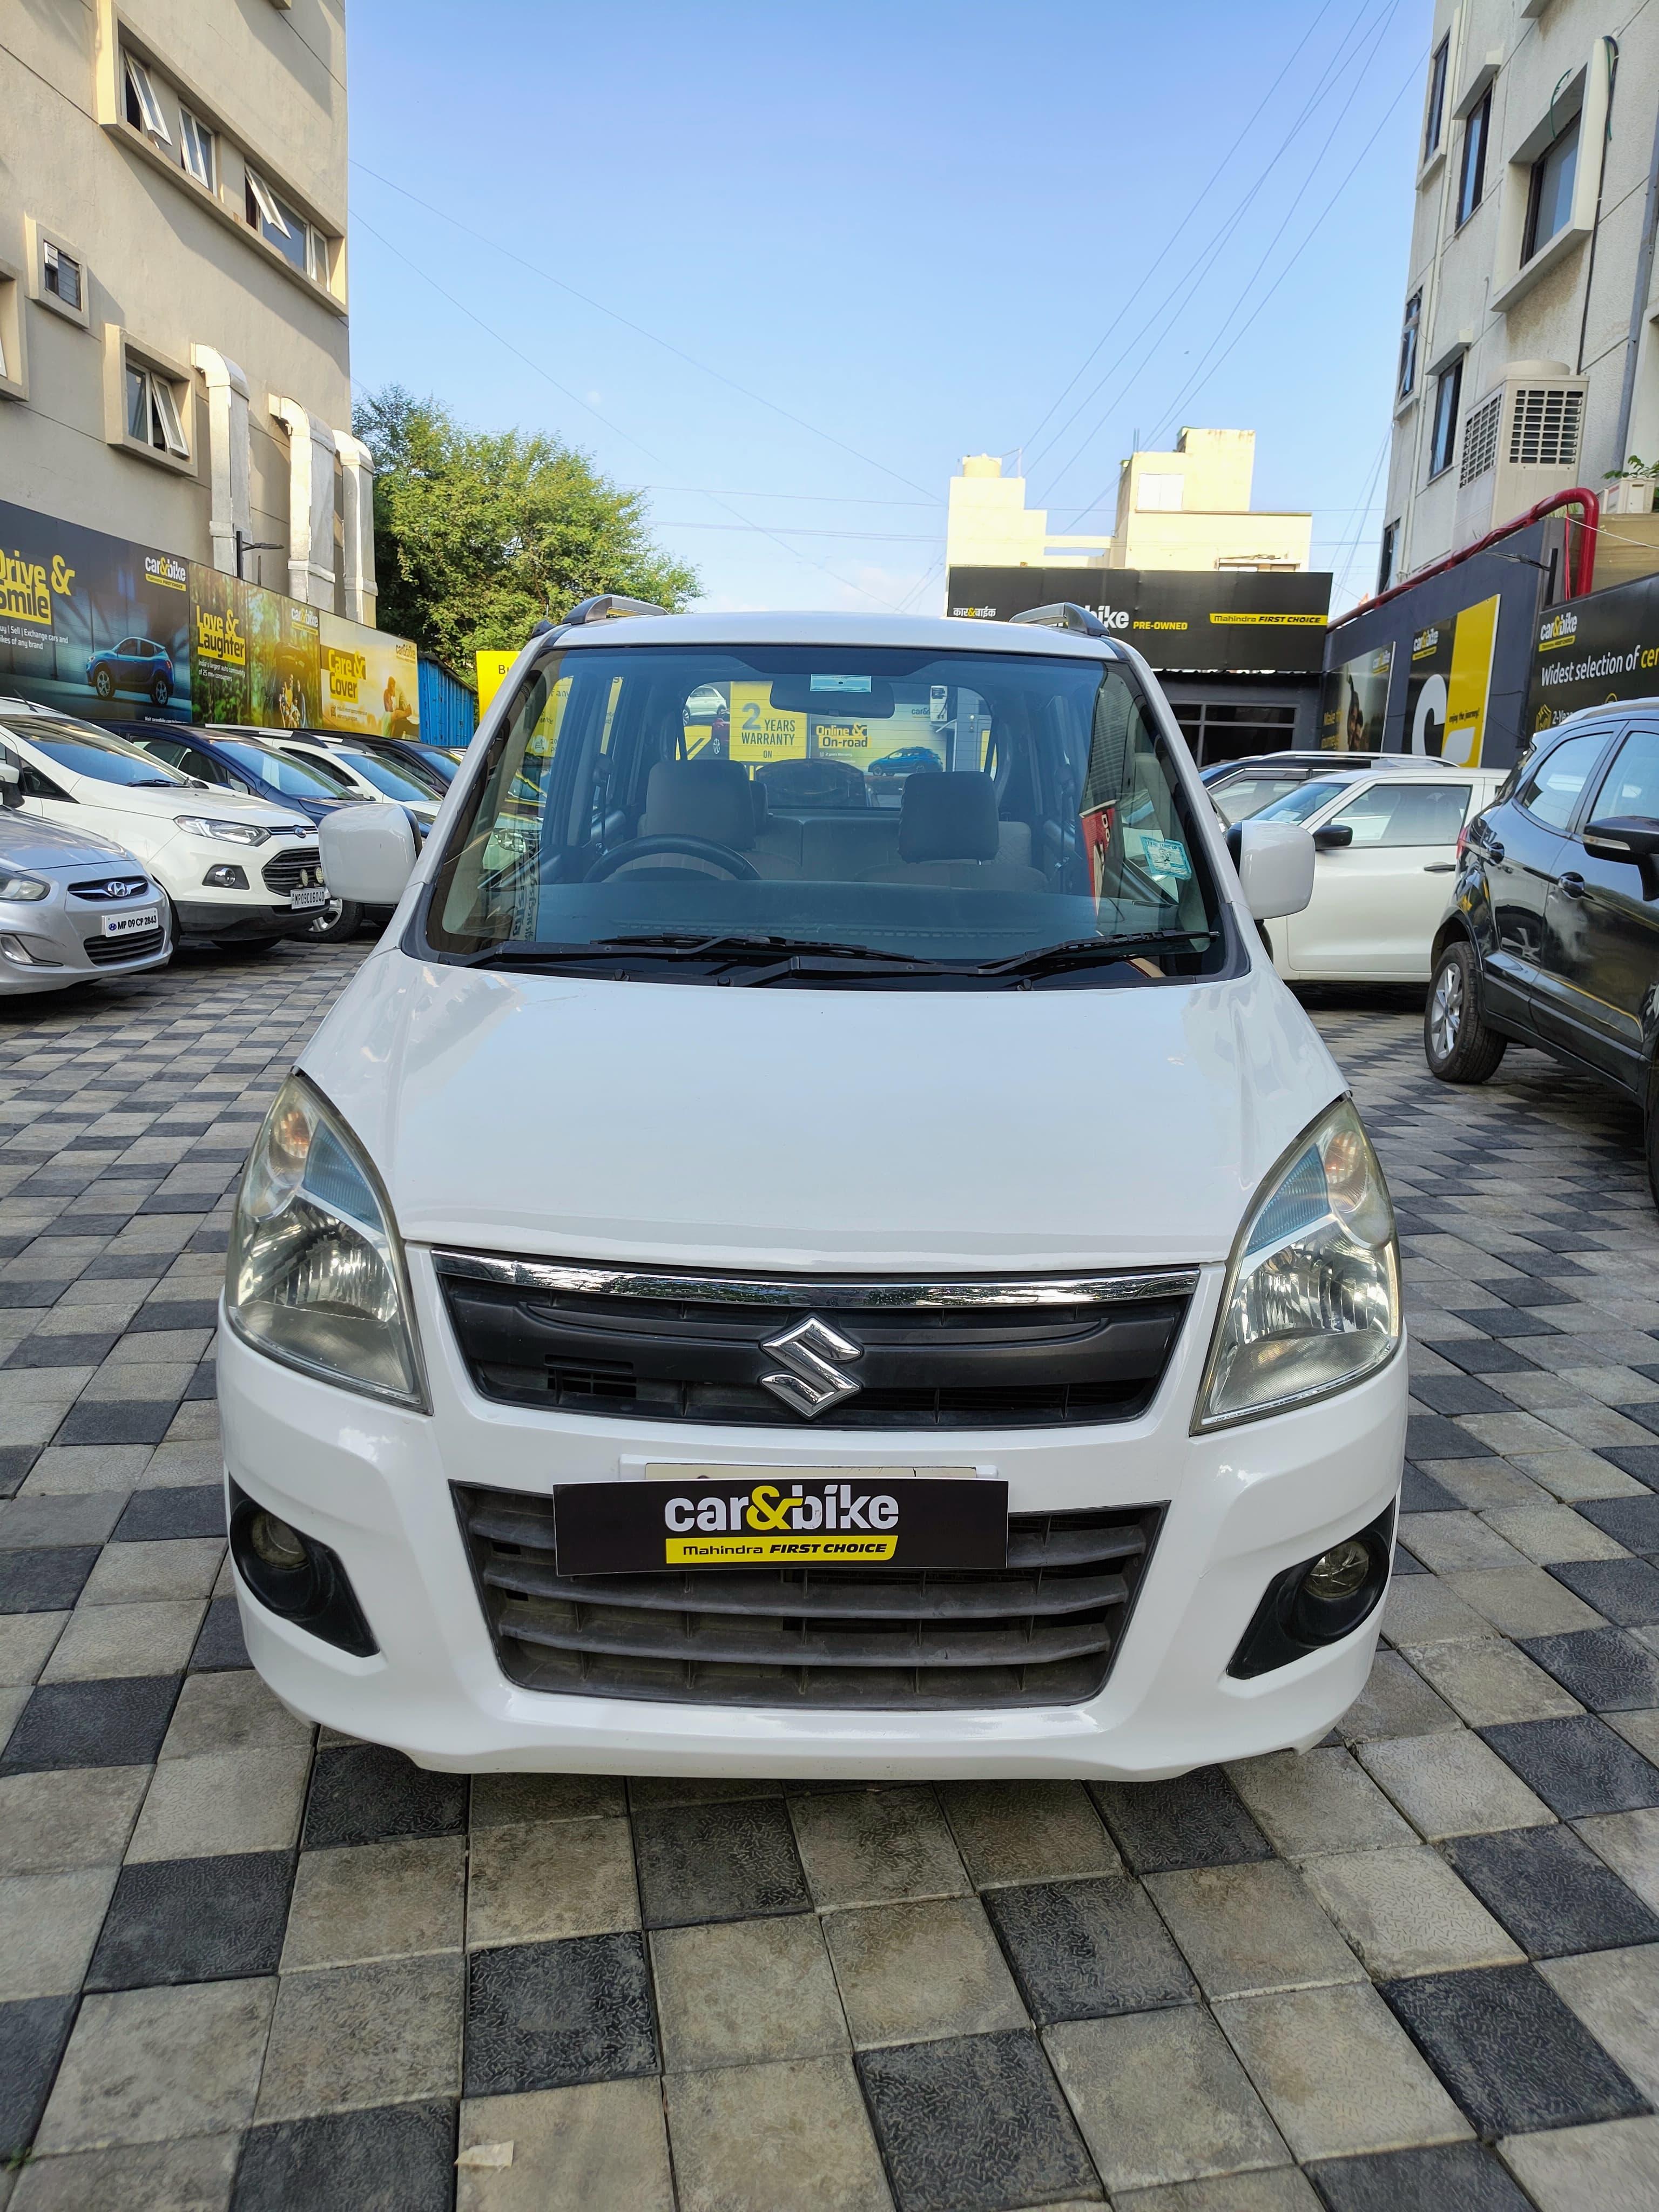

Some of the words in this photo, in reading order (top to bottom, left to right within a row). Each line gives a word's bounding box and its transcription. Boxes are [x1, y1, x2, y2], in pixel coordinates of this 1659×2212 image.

[51, 555, 75, 596] &
[145, 557, 186, 582] car&bike
[197, 605, 223, 632] Love
[226, 609, 239, 638] &
[1134, 622, 1188, 630] PRE-OWNED
[1540, 612, 1577, 640] car&bike
[18, 639, 28, 649] any
[29, 640, 43, 650] brand
[24, 629, 48, 641] Exchange
[198, 626, 244, 658] Laughter
[328, 649, 352, 677] Care
[1541, 662, 1574, 686] Widest
[1575, 655, 1623, 680] selection
[1626, 645, 1641, 670] of
[329, 672, 357, 699] Cover
[741, 703, 761, 731] 2
[765, 719, 795, 731] YEARS
[816, 725, 850, 737] Online
[852, 722, 867, 736] &
[741, 733, 795, 746] WARRANTY
[822, 736, 867, 747] On-road
[118, 920, 127, 930] MP
[128, 919, 136, 928] 09
[136, 918, 144, 926] CP
[665, 1485, 899, 1532] car&bike
[683, 1546, 763, 1555] Mahindra
[769, 1544, 819, 1554] FIRST
[824, 1542, 887, 1554] CHOICE
